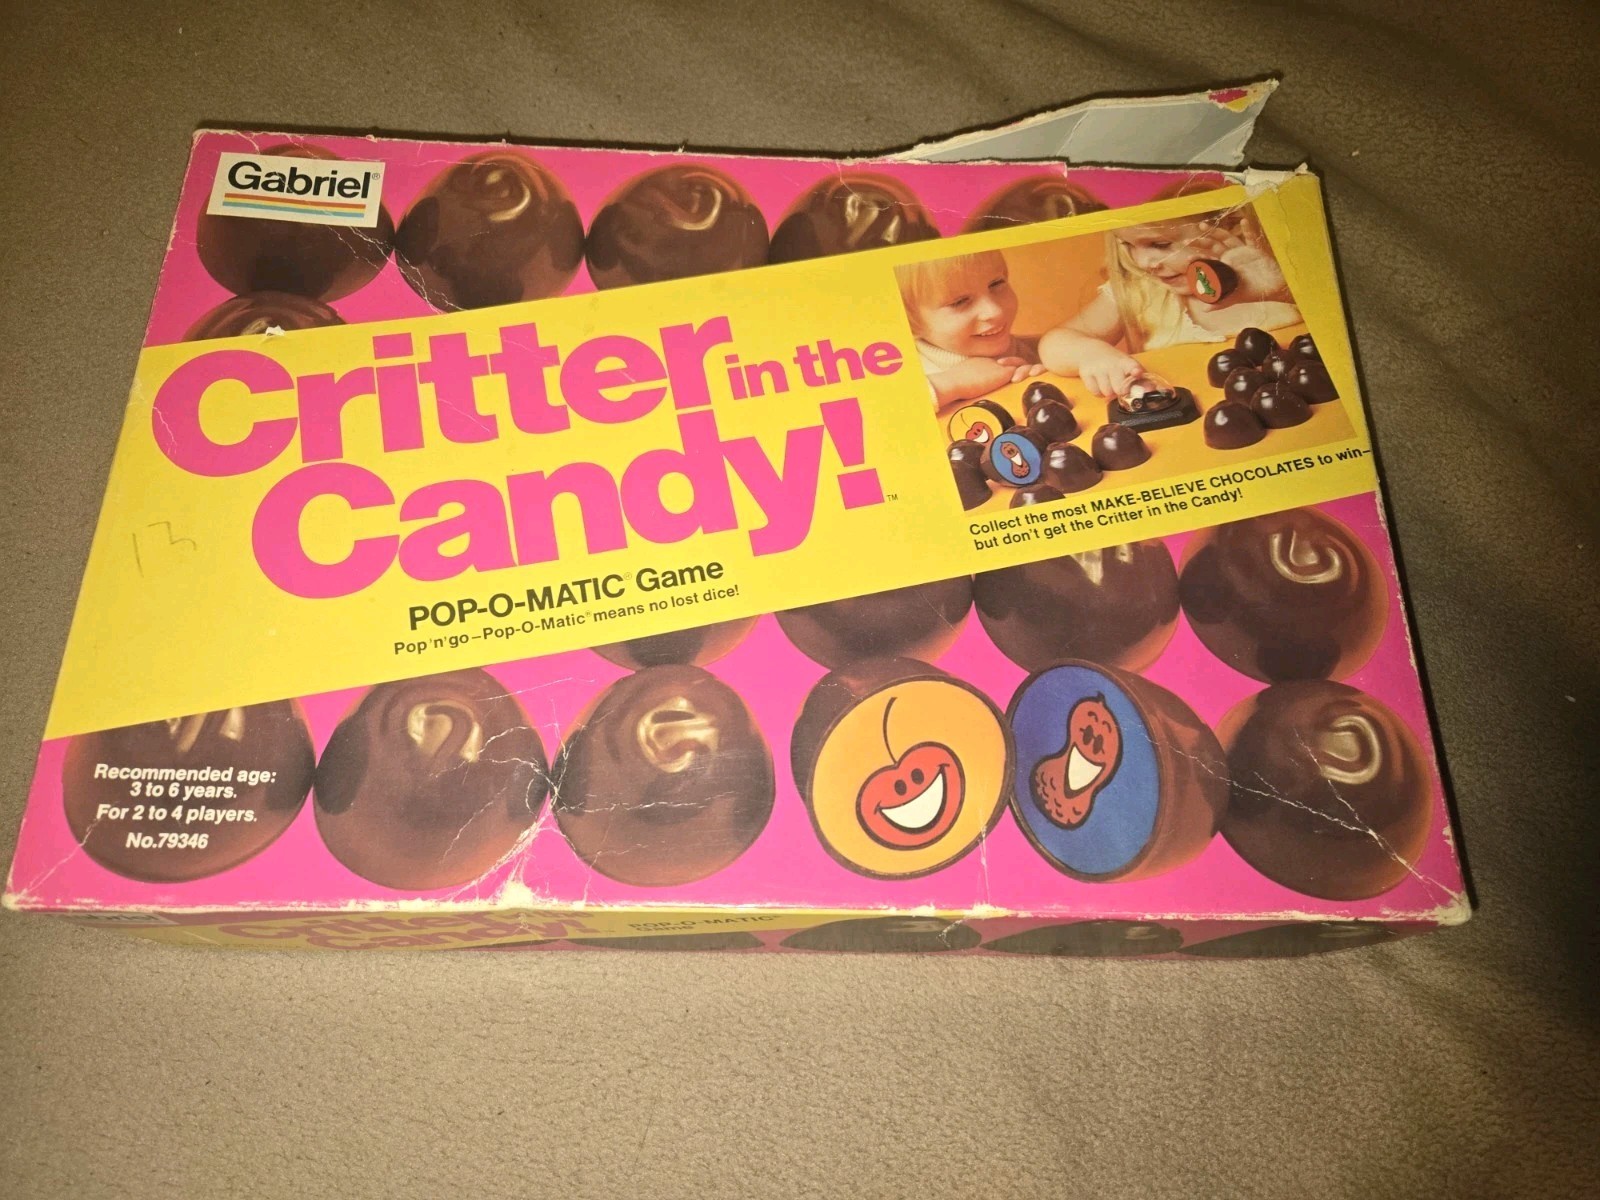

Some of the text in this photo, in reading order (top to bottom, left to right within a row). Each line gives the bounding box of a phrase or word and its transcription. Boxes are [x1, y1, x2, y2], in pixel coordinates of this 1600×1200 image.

[151, 316, 903, 477] Critter in the
[252, 397, 885, 599] Candy!
[969, 515, 1022, 535] Collect
[1024, 511, 1049, 525] the
[1052, 503, 1088, 520] most
[1091, 480, 1207, 513] MAKE-BELIEVE
[1209, 457, 1315, 488] CHOCOLATES
[1317, 454, 1333, 466] to
[974, 487, 1244, 550] but don't get the Critter in the Candy!
[635, 561, 724, 592] Game
[593, 603, 645, 622] means
[649, 600, 668, 612] no
[671, 592, 699, 608] lost
[702, 584, 740, 602] dice!
[94, 763, 277, 785] Recommended age:
[129, 781, 238, 801] 3 to 6 years.
[96, 804, 258, 824] For 2 to 4 players.
[125, 832, 210, 849] No.79346
